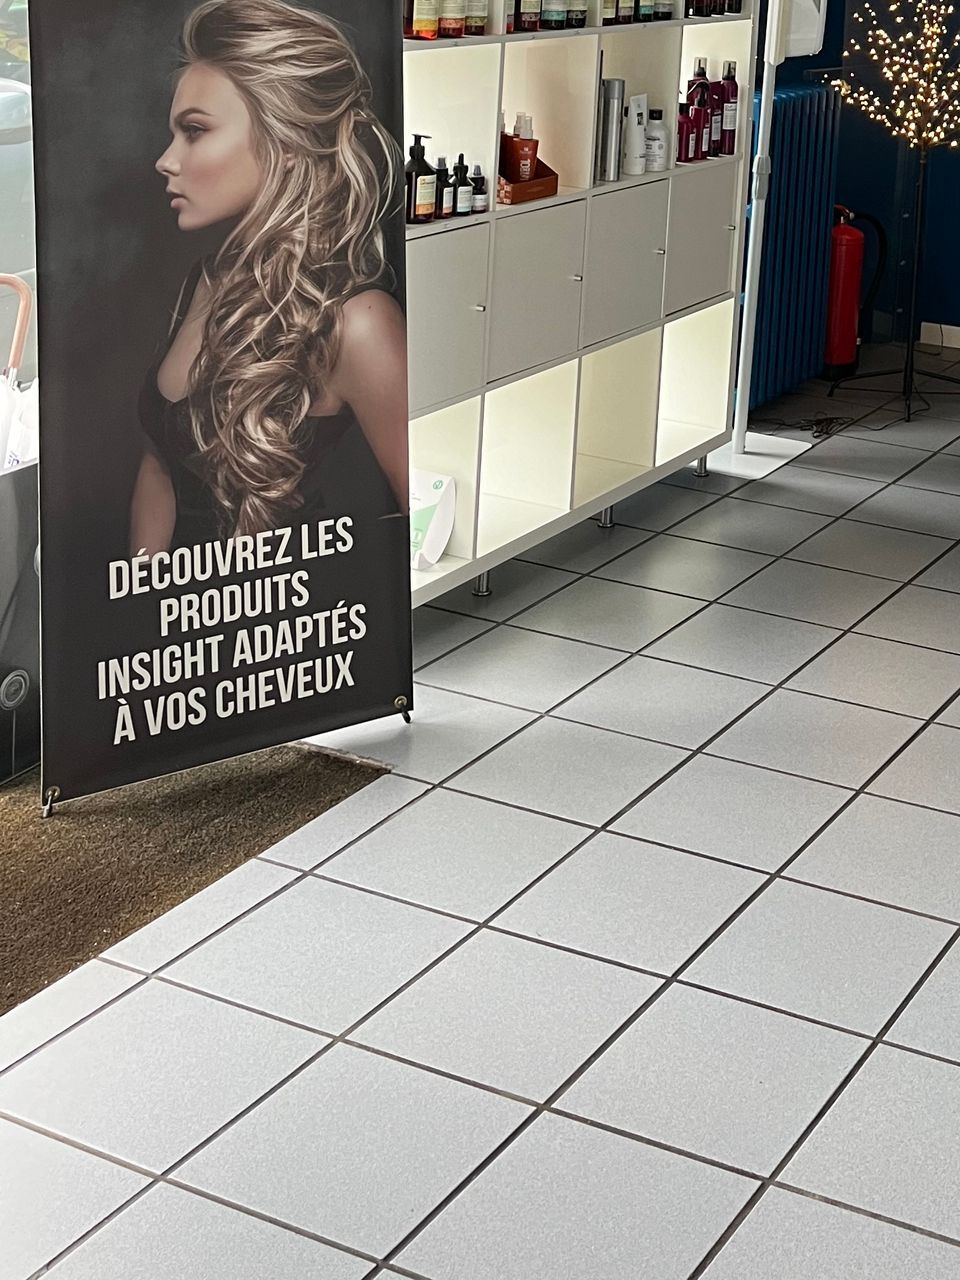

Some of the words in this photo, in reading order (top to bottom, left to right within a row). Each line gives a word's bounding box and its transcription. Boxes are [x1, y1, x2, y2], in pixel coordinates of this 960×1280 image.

[108, 526, 293, 600] DÉCOUVREZ
[301, 515, 355, 560] LES
[159, 570, 311, 638] PRODUITS
[97, 634, 225, 701] INSIGHT
[232, 601, 368, 669] ADAPTÉS
[113, 697, 137, 746] À
[144, 686, 208, 737] VOS
[215, 650, 356, 719] CHEVEUX
